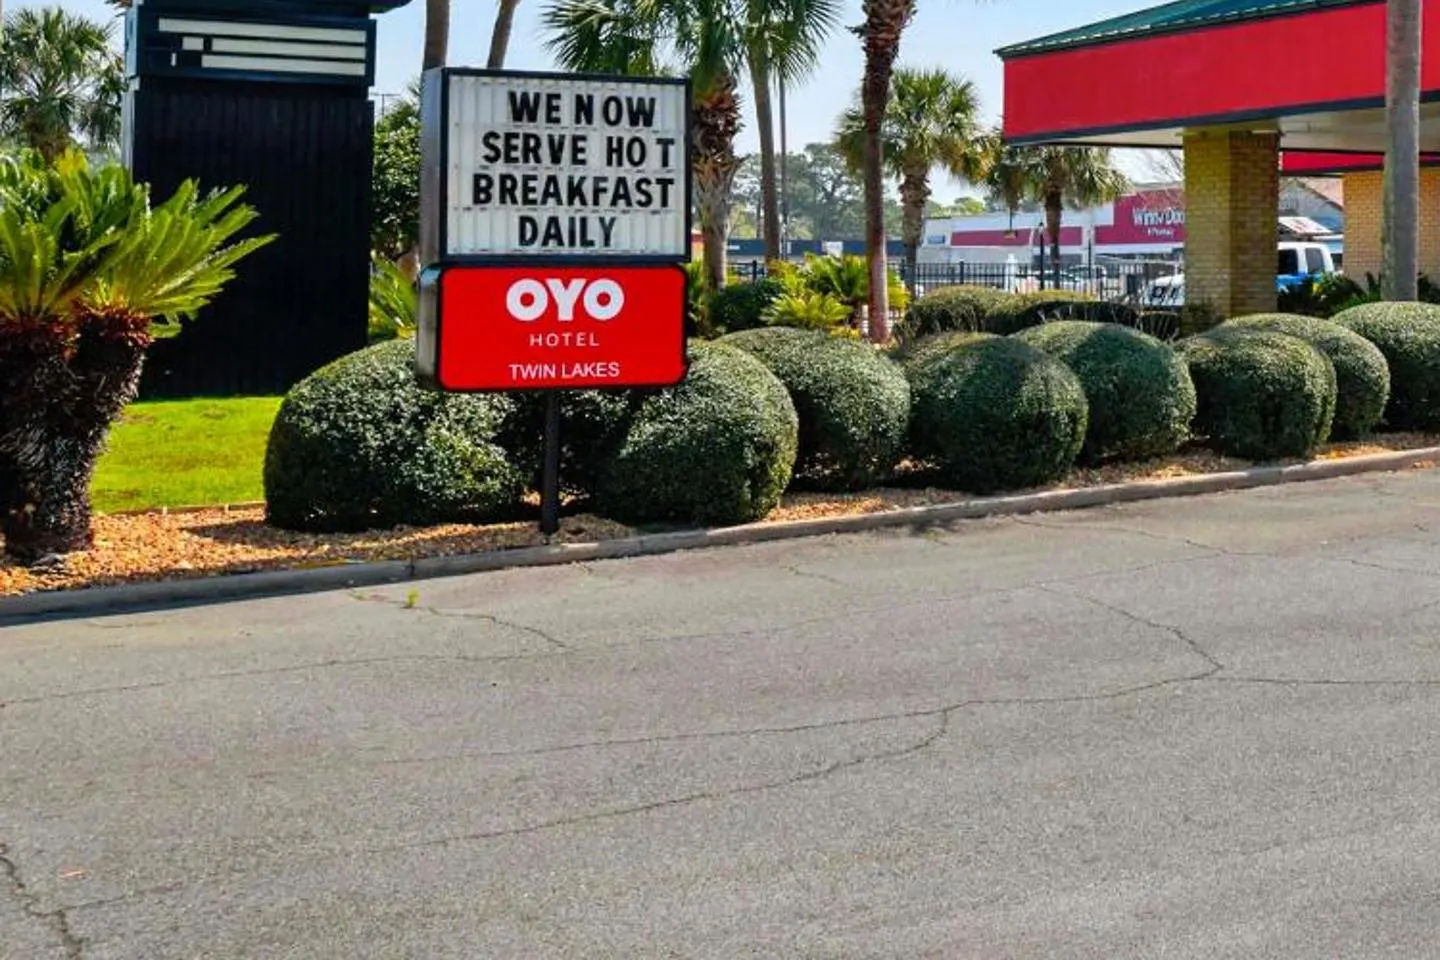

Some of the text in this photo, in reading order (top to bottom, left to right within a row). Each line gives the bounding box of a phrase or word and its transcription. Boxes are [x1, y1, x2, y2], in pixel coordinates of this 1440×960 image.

[509, 91, 657, 127] WE NOW
[482, 131, 675, 169] SERVE HOT
[472, 173, 675, 208] BREAKFAST
[518, 215, 617, 248] DAILY
[506, 278, 625, 322] OYO
[529, 332, 600, 347] HOTEL
[509, 361, 621, 380] TWIN LAKES
